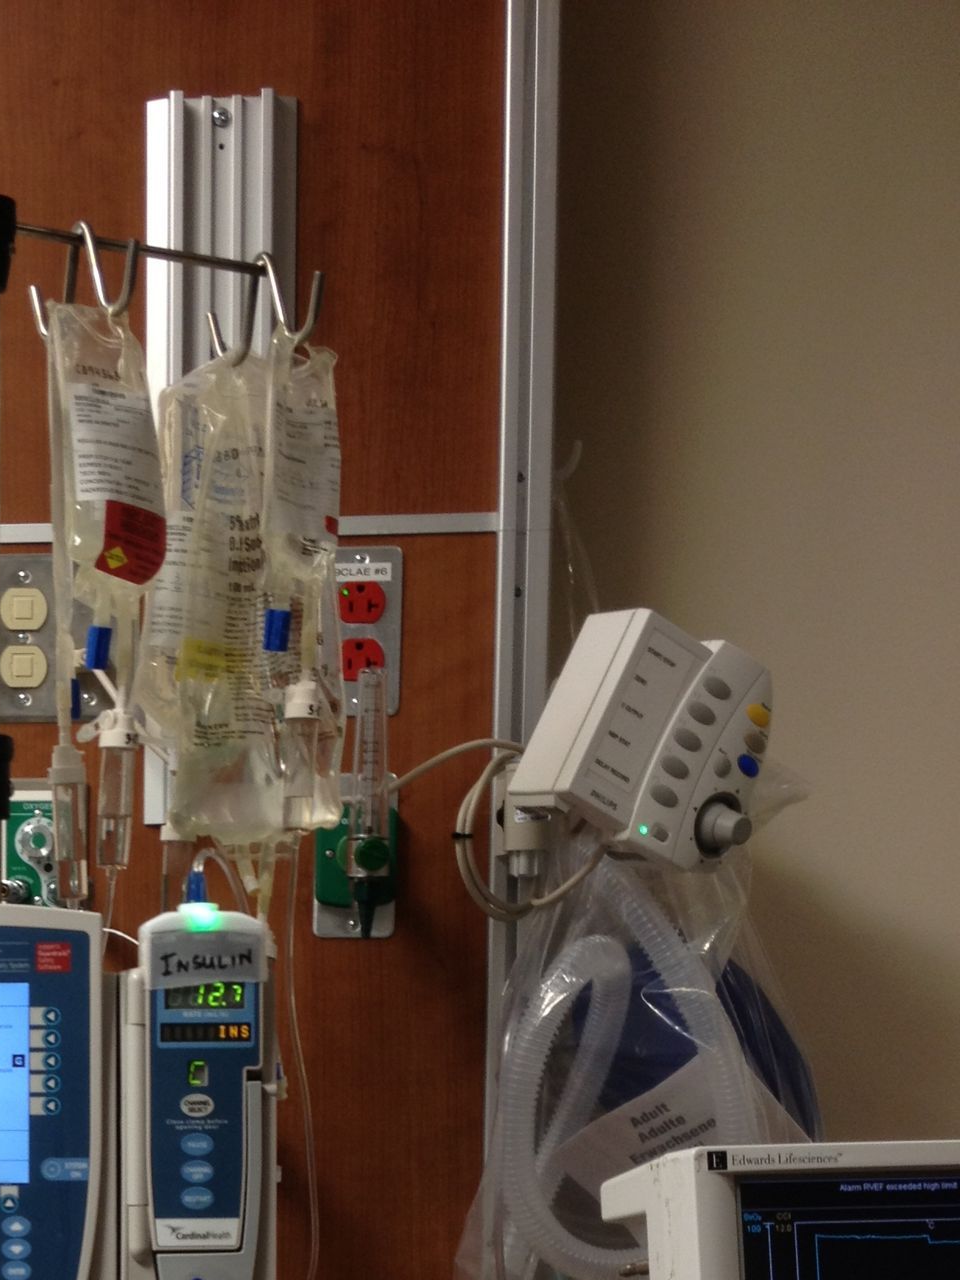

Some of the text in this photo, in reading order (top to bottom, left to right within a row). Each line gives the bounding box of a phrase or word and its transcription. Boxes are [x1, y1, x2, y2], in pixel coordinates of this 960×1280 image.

[160, 949, 253, 976] INSULIN
[196, 981, 242, 1006] 12.7
[218, 1025, 250, 1039] INS
[189, 1061, 205, 1085] C
[630, 1102, 672, 1128] Adult
[628, 1117, 717, 1165] Erwachsene
[638, 1115, 686, 1144] Adulte
[731, 1153, 776, 1166] Edwards
[840, 1182, 958, 1192] Alarm RVEF exceeded high limit
[176, 1231, 231, 1240] CardinalHealth
[746, 1224, 762, 1233] 100
